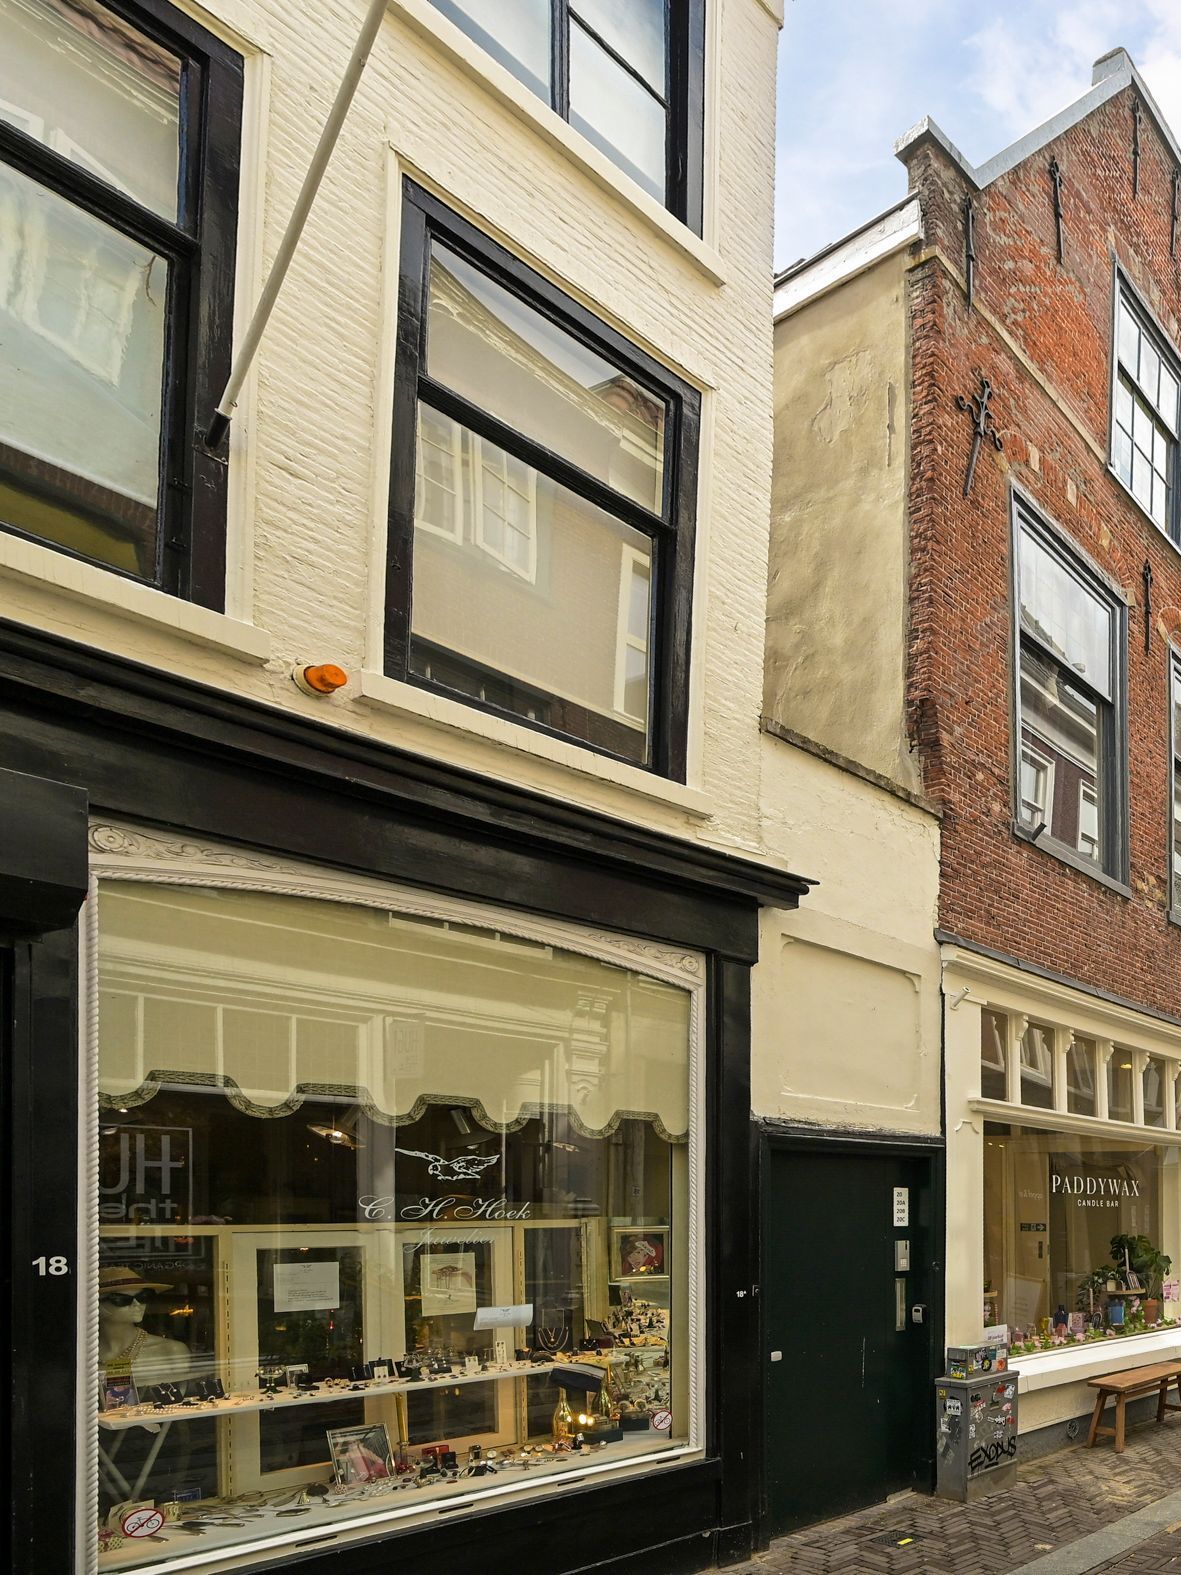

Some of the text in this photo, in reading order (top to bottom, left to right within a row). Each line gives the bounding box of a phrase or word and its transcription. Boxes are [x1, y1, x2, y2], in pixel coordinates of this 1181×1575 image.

[1052, 1174, 1139, 1197] PADDYWAX
[358, 1195, 531, 1220] C. H. Hoek
[1077, 1199, 1104, 1207] CANDLE
[32, 1256, 68, 1276] 18
